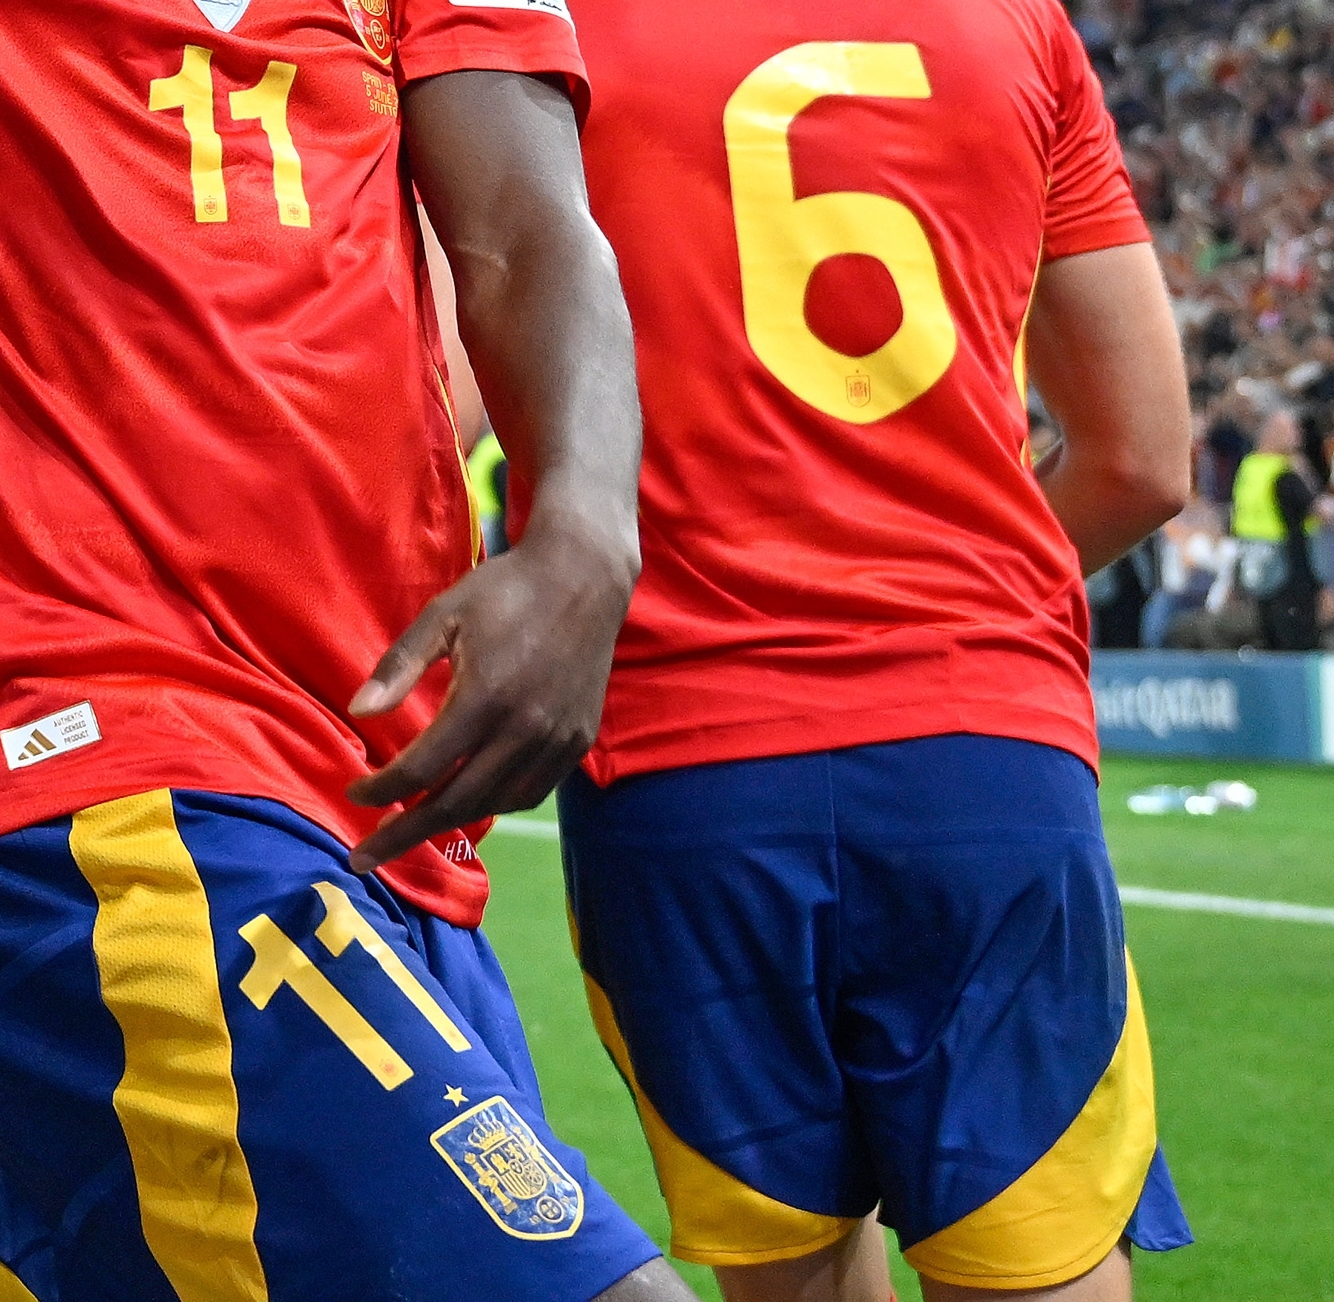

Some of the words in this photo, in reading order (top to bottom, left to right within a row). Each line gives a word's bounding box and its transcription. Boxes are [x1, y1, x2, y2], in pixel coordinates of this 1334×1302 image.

[149, 44, 311, 229] 11
[723, 41, 956, 424] 6
[238, 881, 472, 1091] 11
